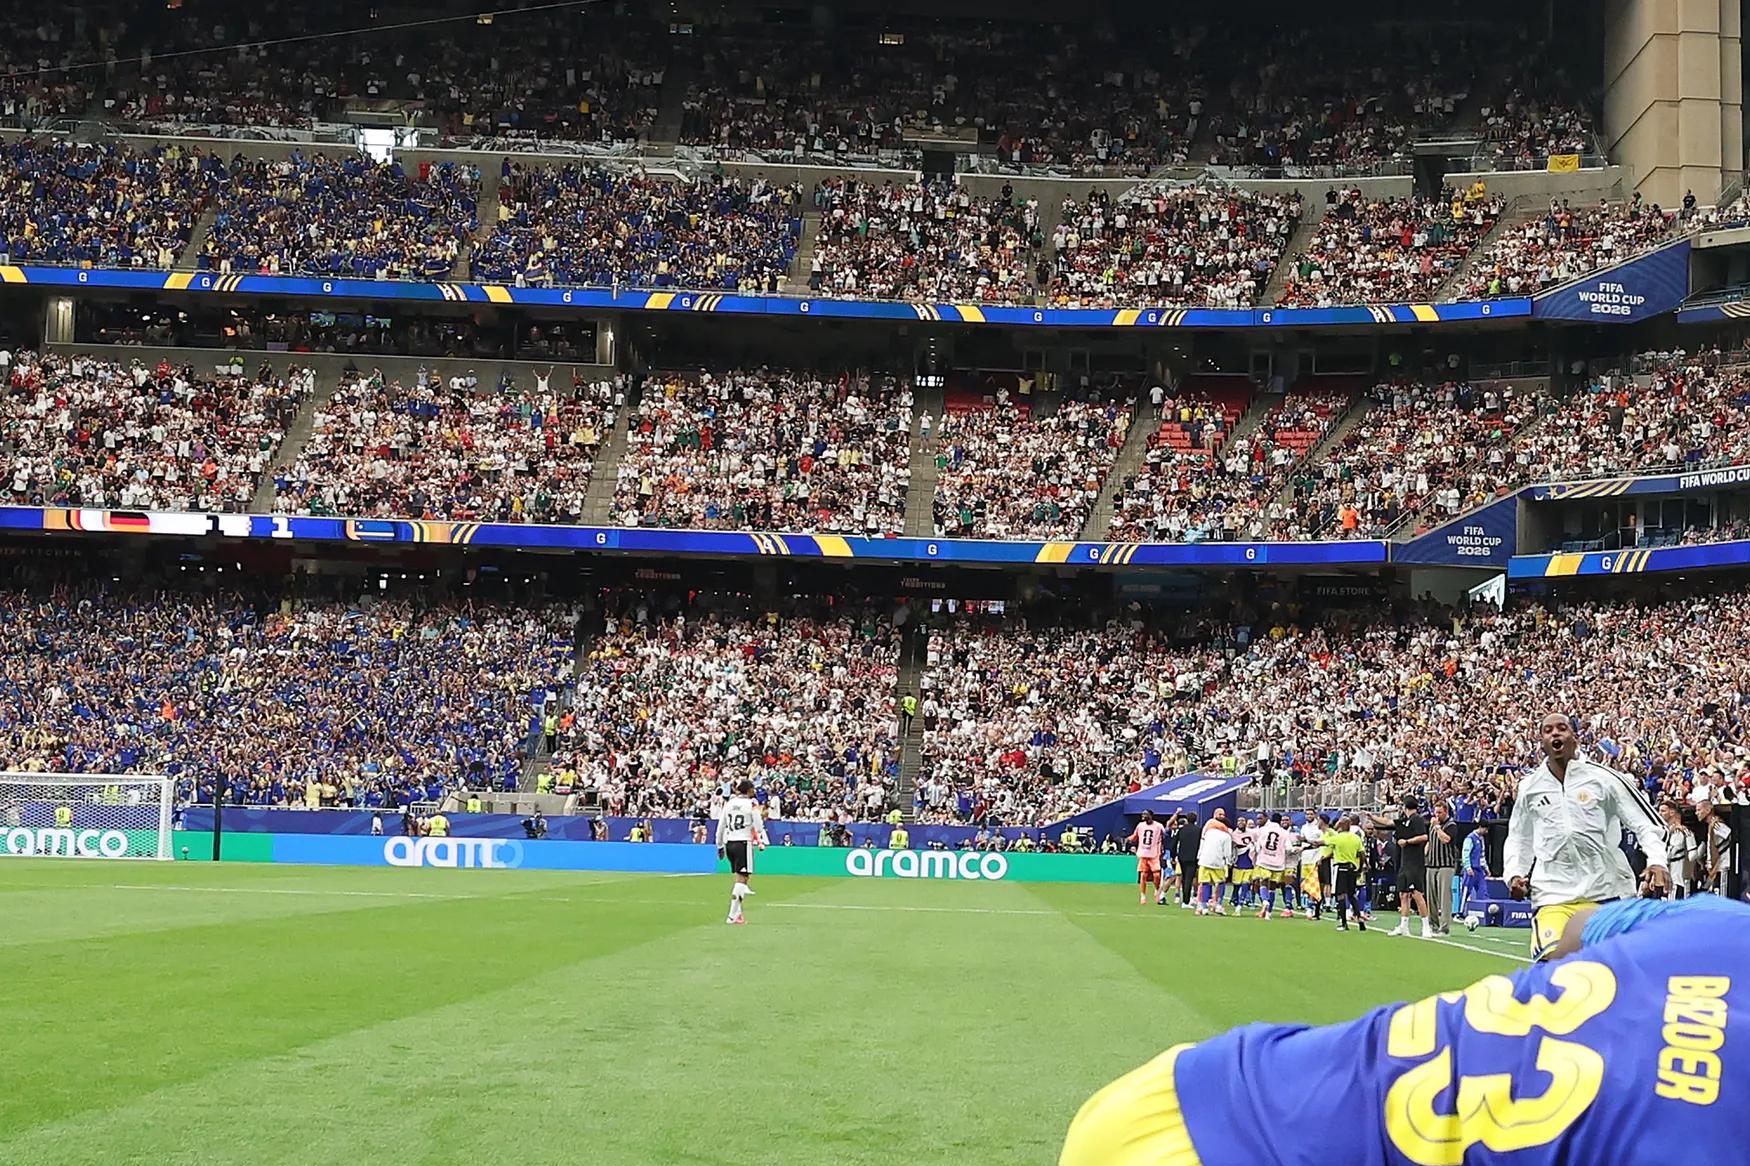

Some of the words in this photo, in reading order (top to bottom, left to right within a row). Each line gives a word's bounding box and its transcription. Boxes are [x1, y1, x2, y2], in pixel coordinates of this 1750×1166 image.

[1598, 282, 1625, 294] FIFA
[1579, 292, 1620, 305] WORLD
[1621, 295, 1645, 306] CUP
[1590, 303, 1631, 316] 2026
[1680, 473, 1701, 489] FIFA
[1701, 471, 1735, 486] WORLD
[1463, 526, 1485, 536] FIFA
[1447, 536, 1481, 547] WORLD
[1482, 536, 1502, 547] CUP
[1457, 546, 1491, 557] 2026
[1602, 557, 1611, 570] G
[846, 849, 1008, 880] aramco
